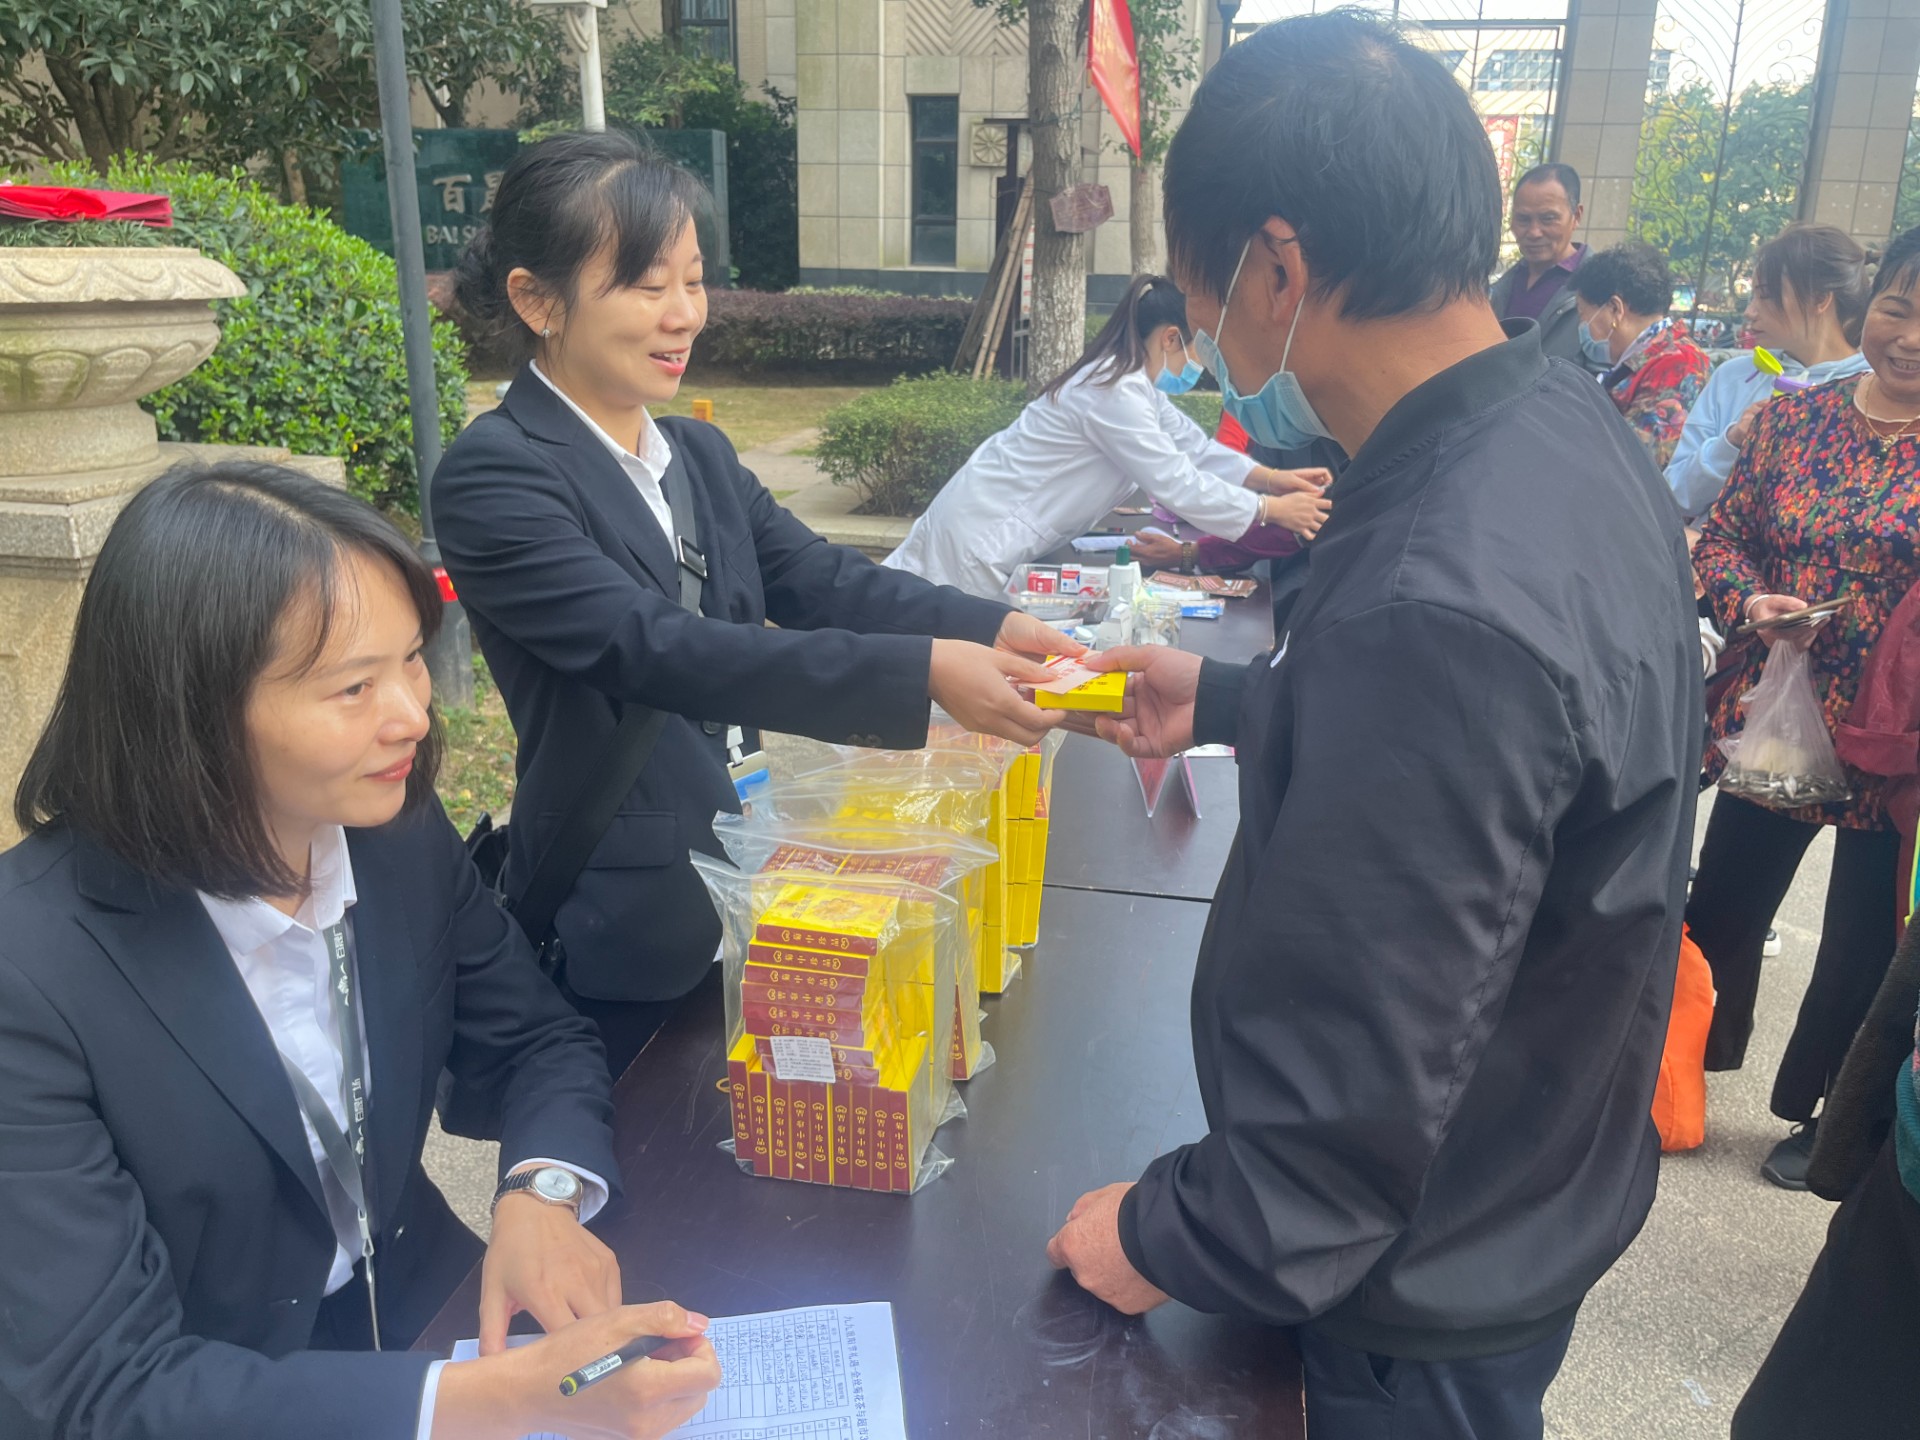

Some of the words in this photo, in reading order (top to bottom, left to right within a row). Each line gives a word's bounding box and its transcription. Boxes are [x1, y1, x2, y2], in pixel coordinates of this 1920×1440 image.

[426, 225, 458, 245] BAI
[333, 921, 345, 960] 百晟广
[793, 932, 839, 947] 菊中珍品
[785, 953, 831, 967] 菊中珍品
[777, 990, 824, 1004] 菊中珍品
[781, 973, 828, 987] 菊中珍品
[779, 1009, 825, 1022] 菊中珍品
[735, 1091, 746, 1130] 菊中珍品
[755, 1105, 765, 1145] 菊中珍品
[776, 1107, 785, 1148] 菊中珍品
[796, 1109, 805, 1150] 菊中珍品
[815, 1112, 824, 1153] 菊中珍品
[837, 1114, 846, 1155] 菊中珍品
[857, 1116, 866, 1157] 菊中珍品
[876, 1119, 886, 1160] 菊中珍品
[895, 1122, 905, 1161] 菊中珍品
